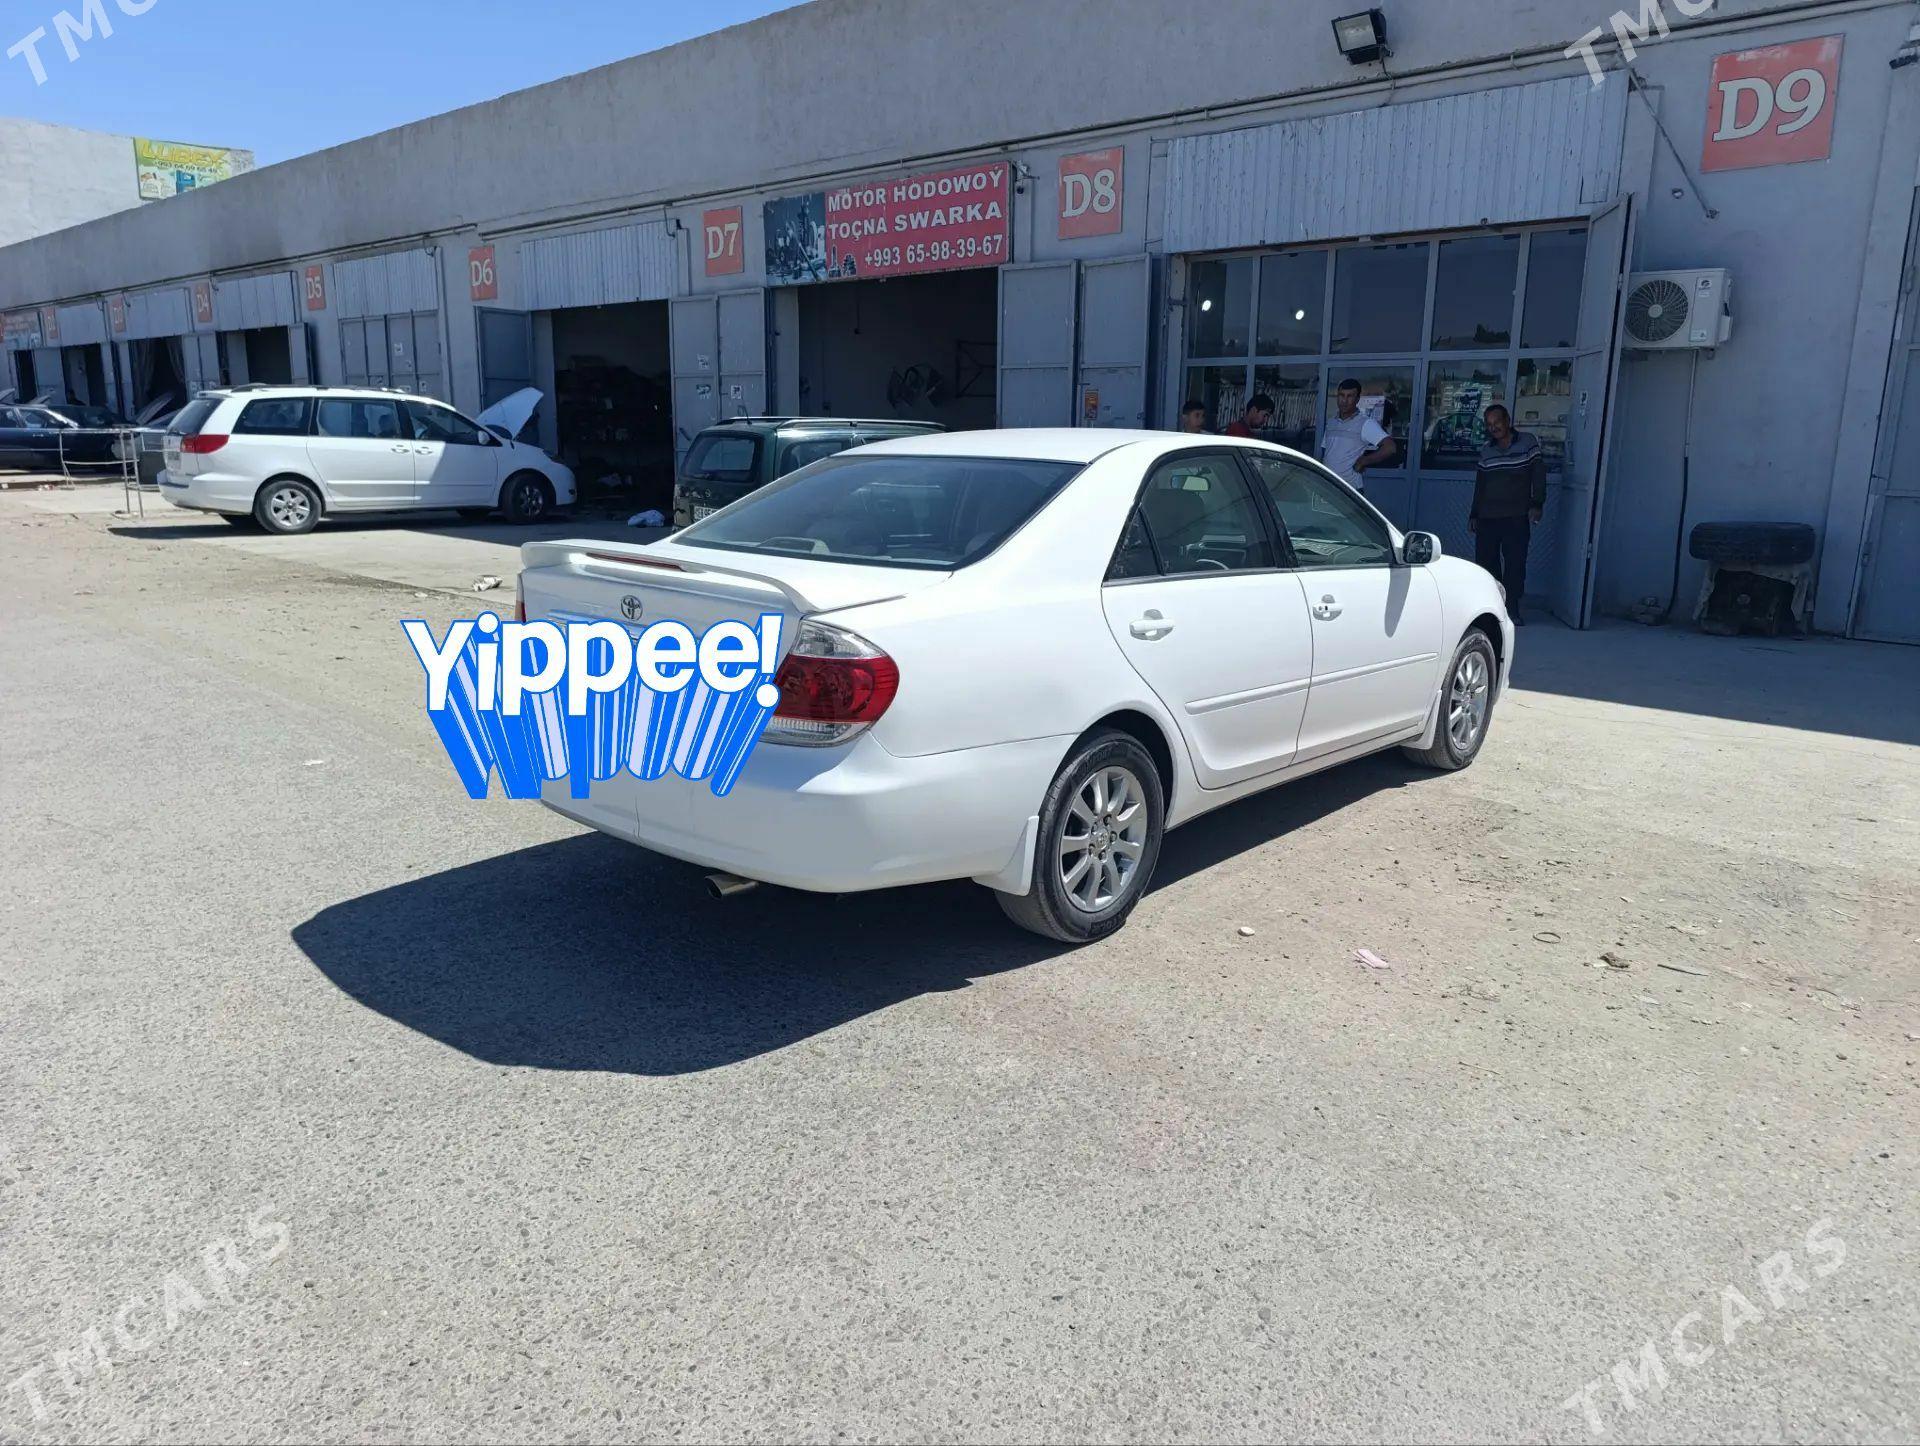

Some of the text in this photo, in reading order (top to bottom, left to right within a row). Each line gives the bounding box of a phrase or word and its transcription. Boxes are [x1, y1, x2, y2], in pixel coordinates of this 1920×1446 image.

[1712, 68, 1826, 142] D9
[1062, 168, 1116, 218] D8
[828, 201, 1002, 241] TOÇNA SWARKA
[706, 222, 739, 259] D7
[865, 234, 1003, 268] +993 65-98-39-67
[306, 276, 322, 299] D5
[471, 258, 493, 287] D6
